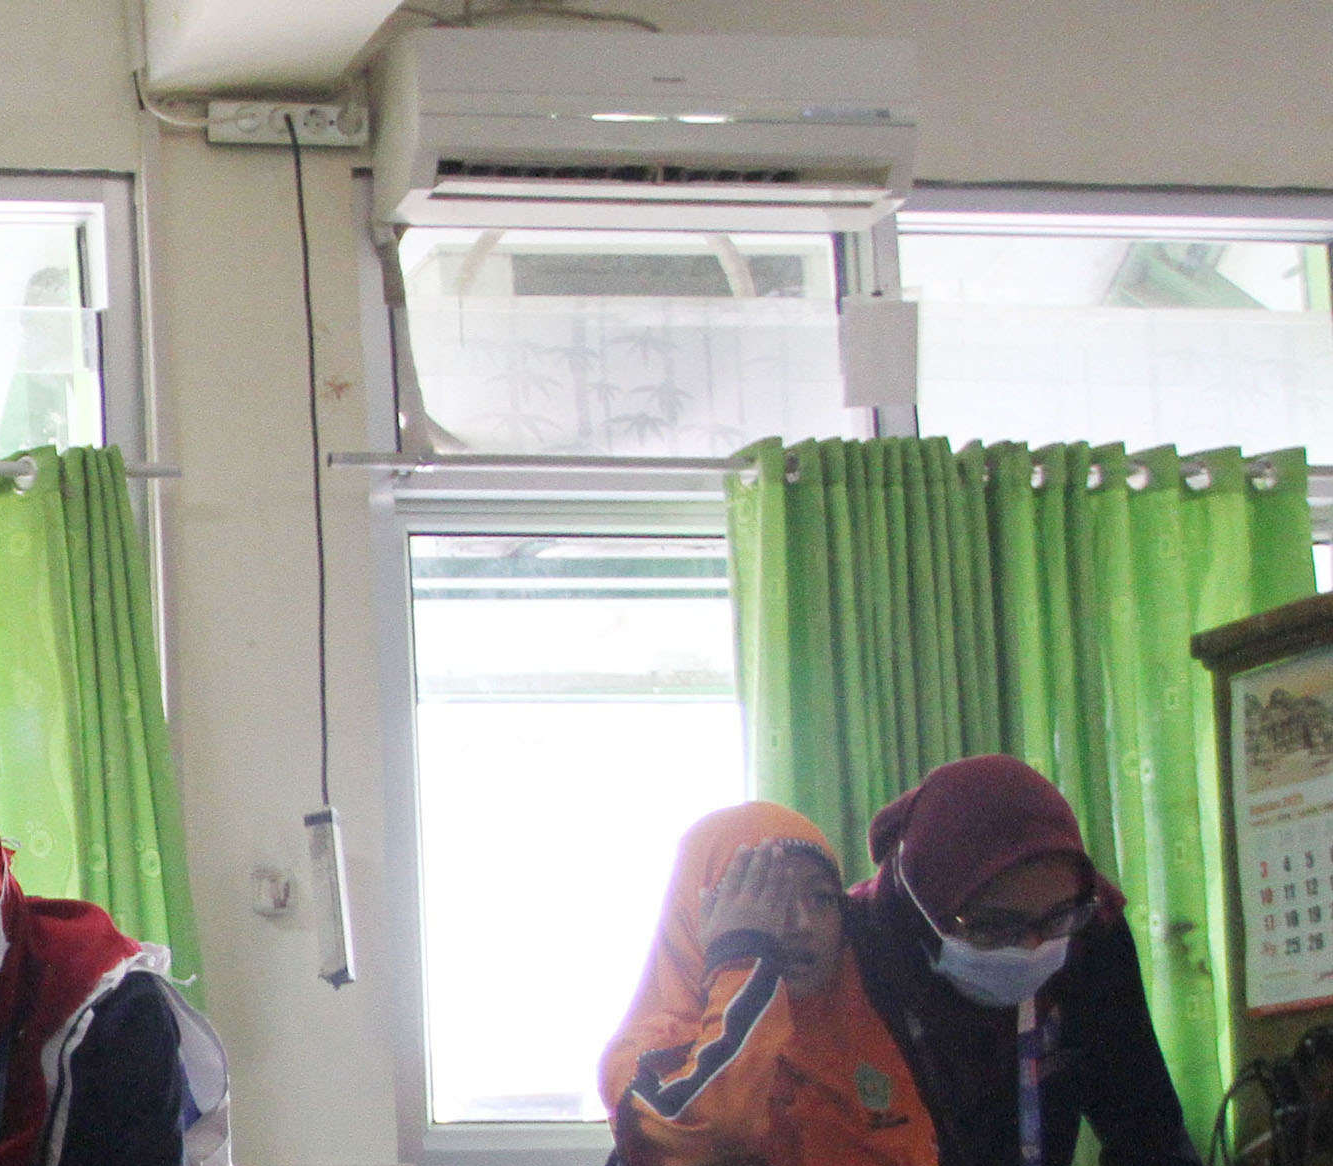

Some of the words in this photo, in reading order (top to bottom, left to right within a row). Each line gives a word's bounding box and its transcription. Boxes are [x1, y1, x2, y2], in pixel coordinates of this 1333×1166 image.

[1260, 861, 1269, 879] 3
[1284, 855, 1292, 872] 4
[1285, 909, 1299, 928] 18
[1285, 936, 1301, 956] 25
[1308, 932, 1324, 952] 26
